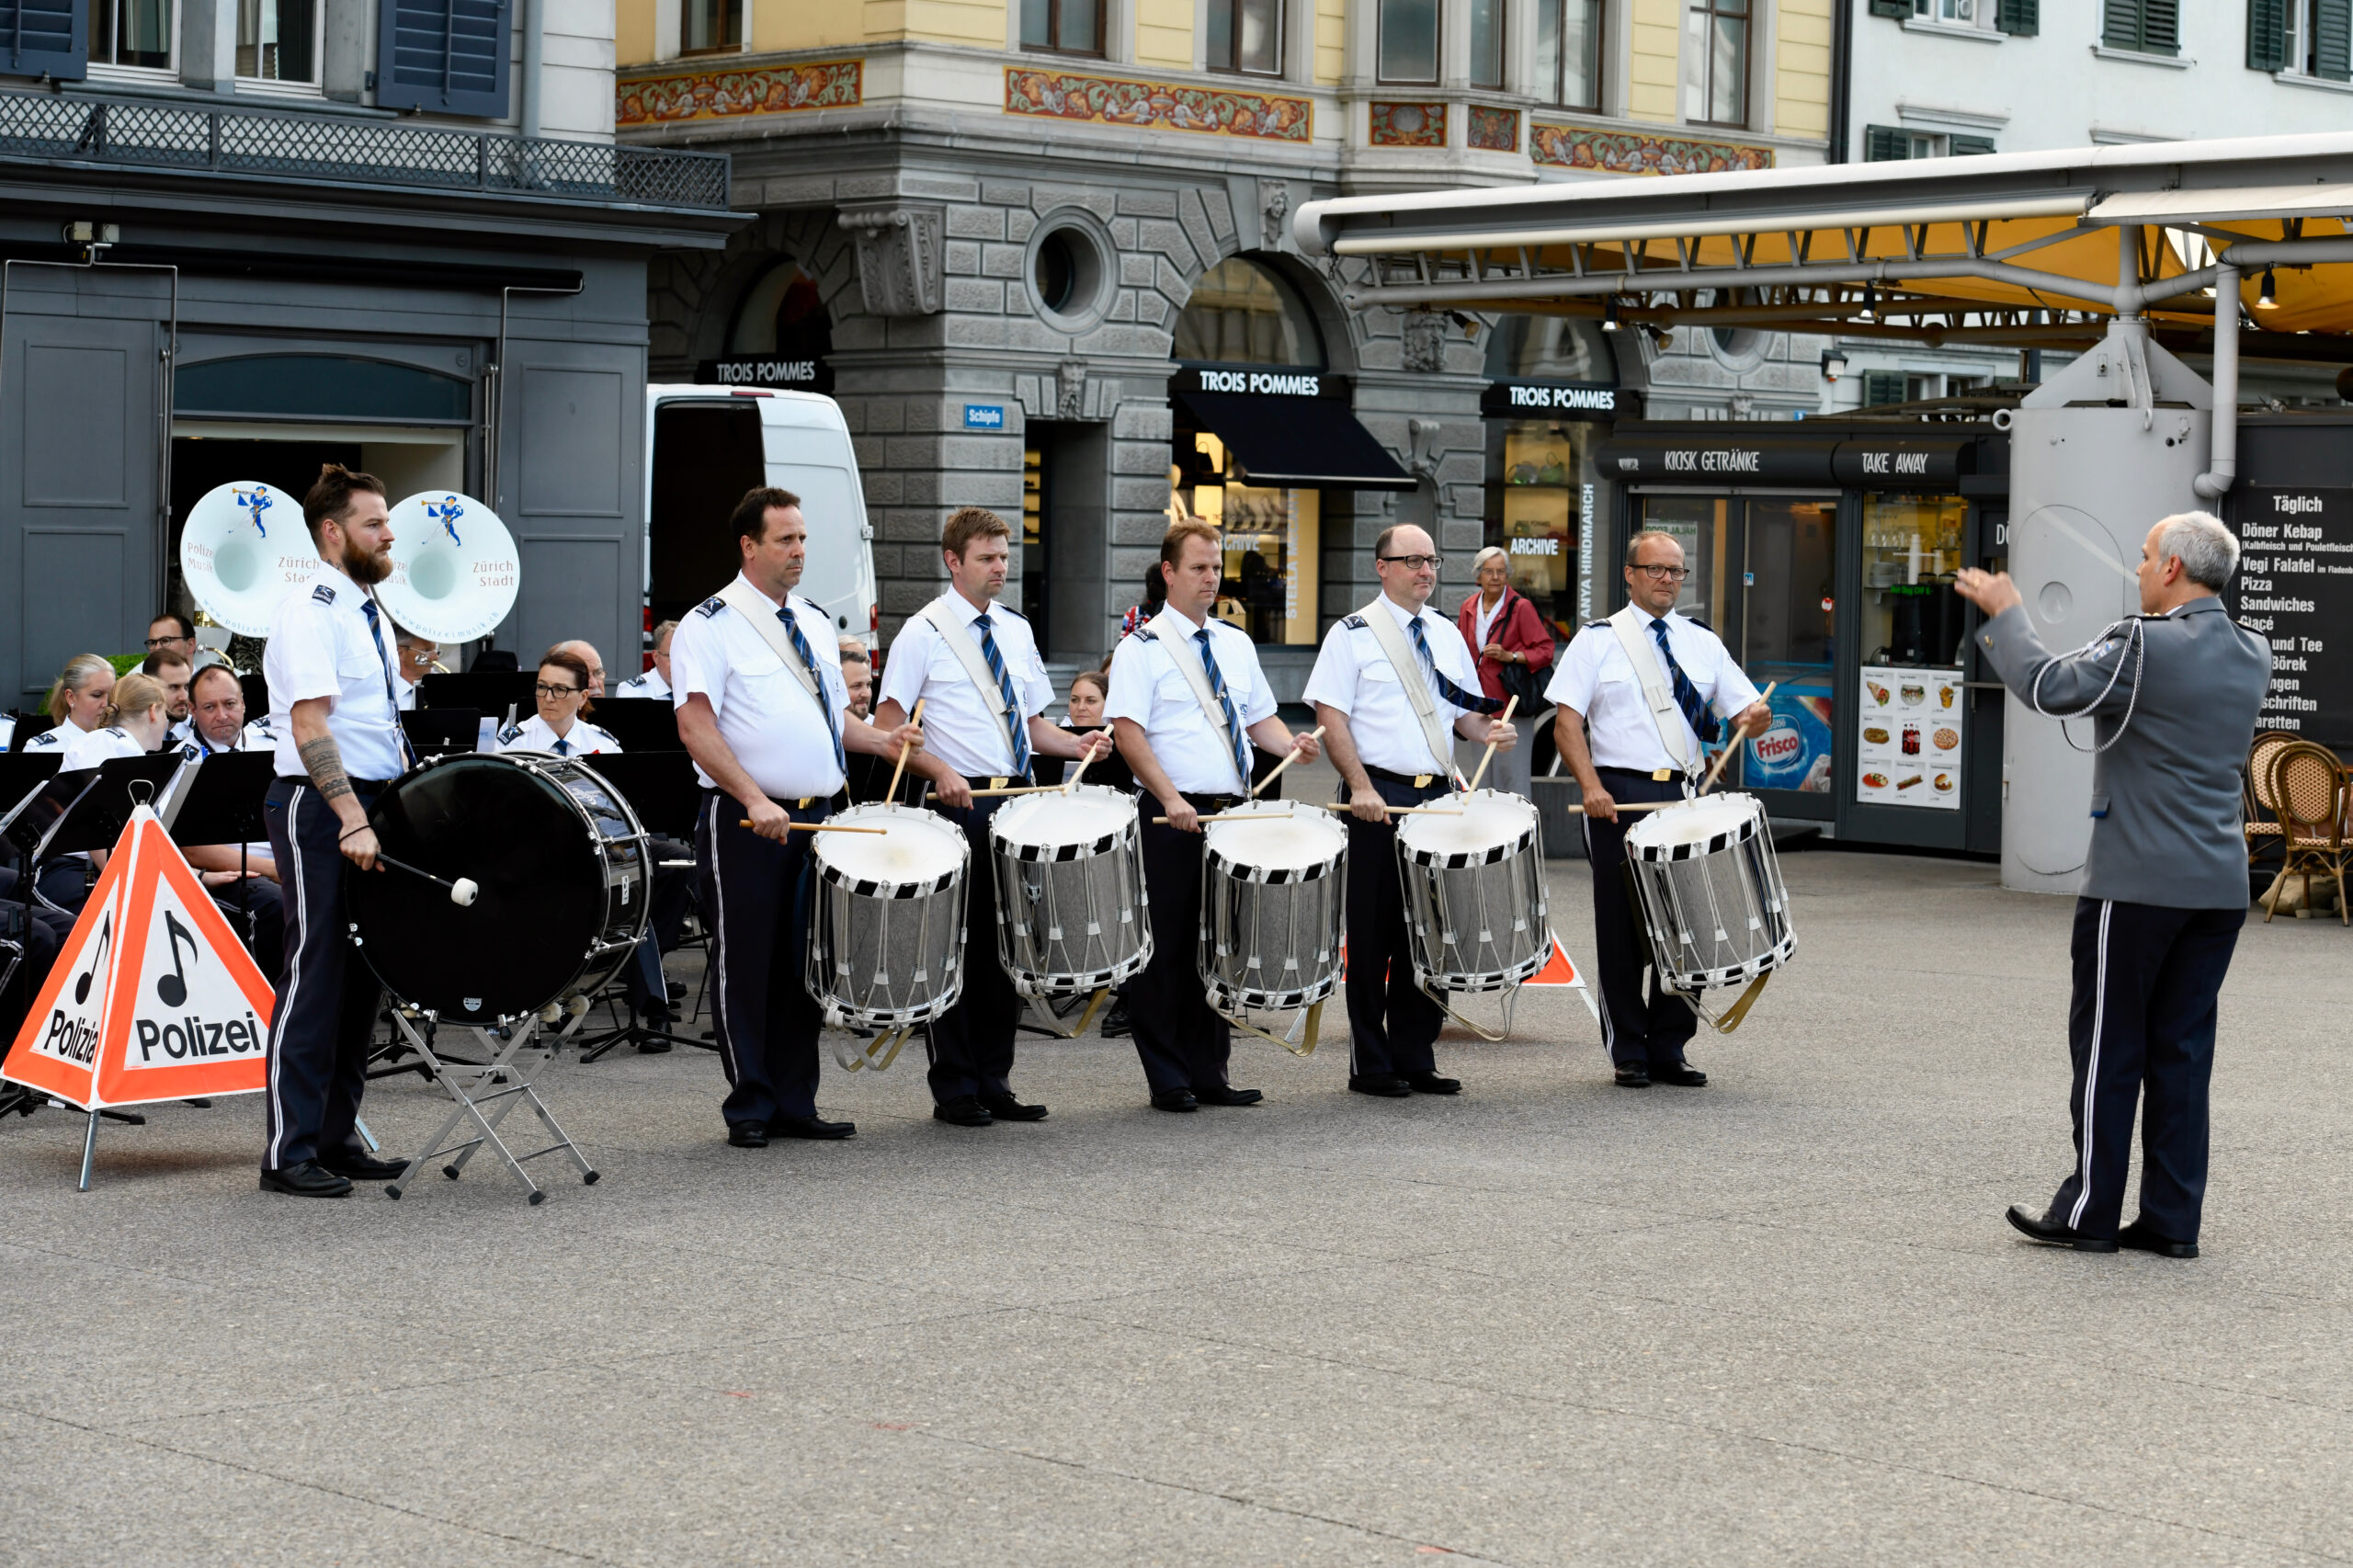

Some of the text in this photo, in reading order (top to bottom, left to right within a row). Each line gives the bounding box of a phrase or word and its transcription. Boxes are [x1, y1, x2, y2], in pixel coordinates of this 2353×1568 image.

[717, 361, 815, 382] TROIS POMMES
[1199, 370, 1320, 396] TROIS POMMES
[1509, 386, 1615, 410] TROIS POMMES
[969, 409, 1001, 426] Schipfe
[1665, 450, 1699, 472] KIOSK
[1701, 449, 1760, 472] GETRÄNKE
[1862, 452, 1928, 473] TAKE AWAY
[2273, 495, 2323, 515] Täglich
[2242, 522, 2323, 541] Döner Kebap
[1220, 534, 1260, 551] CHIVE
[1510, 538, 1559, 555] ARCHIVE
[1580, 483, 1594, 619] ANYA HINDMARCH
[2242, 540, 2286, 551] (Kalbfleisch
[2289, 542, 2302, 551] und
[278, 556, 320, 570] Zürich
[472, 560, 514, 574] Zürich
[2243, 556, 2268, 574] Vegi
[2273, 557, 2314, 573] Falafel
[2328, 565, 2353, 574] Fladenb
[480, 575, 515, 587] Stadt
[1285, 561, 1298, 619] STELLA
[2241, 575, 2273, 591] Pizza
[2241, 596, 2315, 612] Sandwiches
[2272, 637, 2323, 653] und Tee
[1756, 736, 1798, 759] Frisco
[43, 1008, 99, 1065] Polizia
[136, 1011, 262, 1062] Polizei
